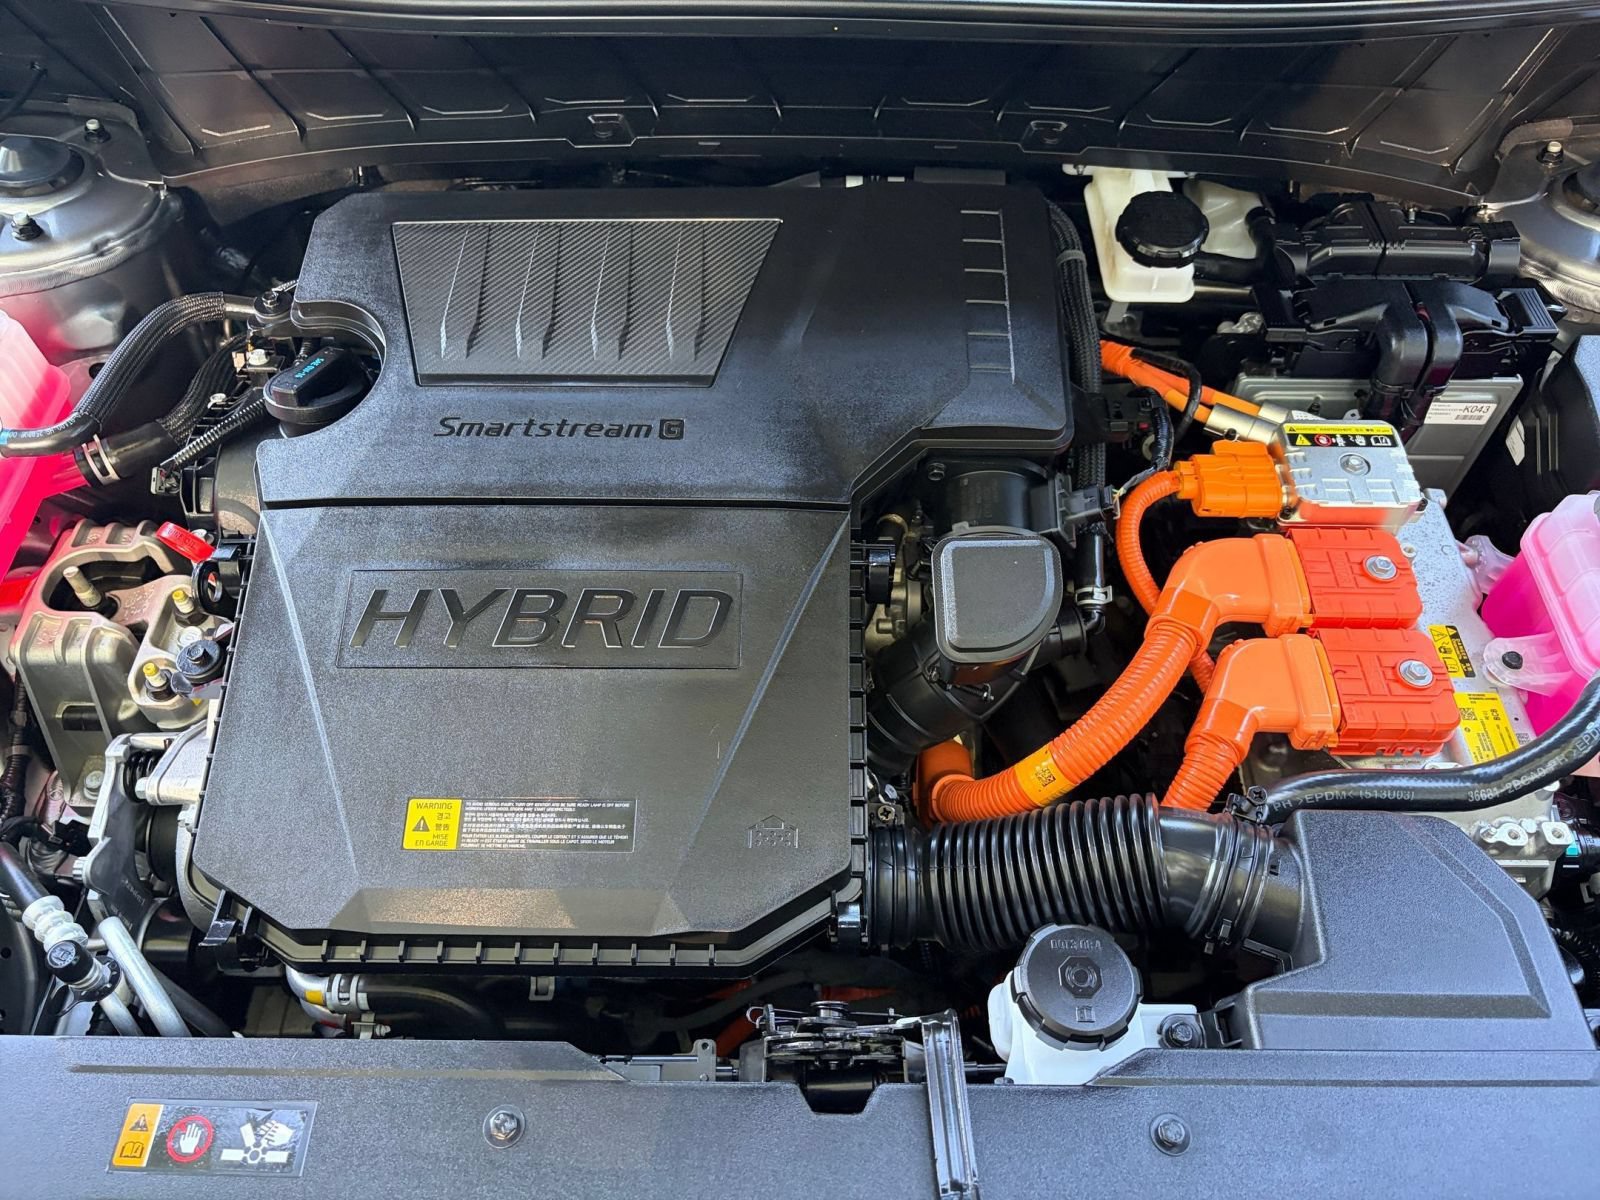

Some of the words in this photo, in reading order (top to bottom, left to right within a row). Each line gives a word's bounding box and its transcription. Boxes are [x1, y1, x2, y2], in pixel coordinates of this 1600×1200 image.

[1462, 405, 1490, 414] K043
[433, 416, 653, 438] Smartstream
[661, 420, 683, 439] G
[348, 587, 734, 649] HYBRID
[436, 812, 451, 821] 경고
